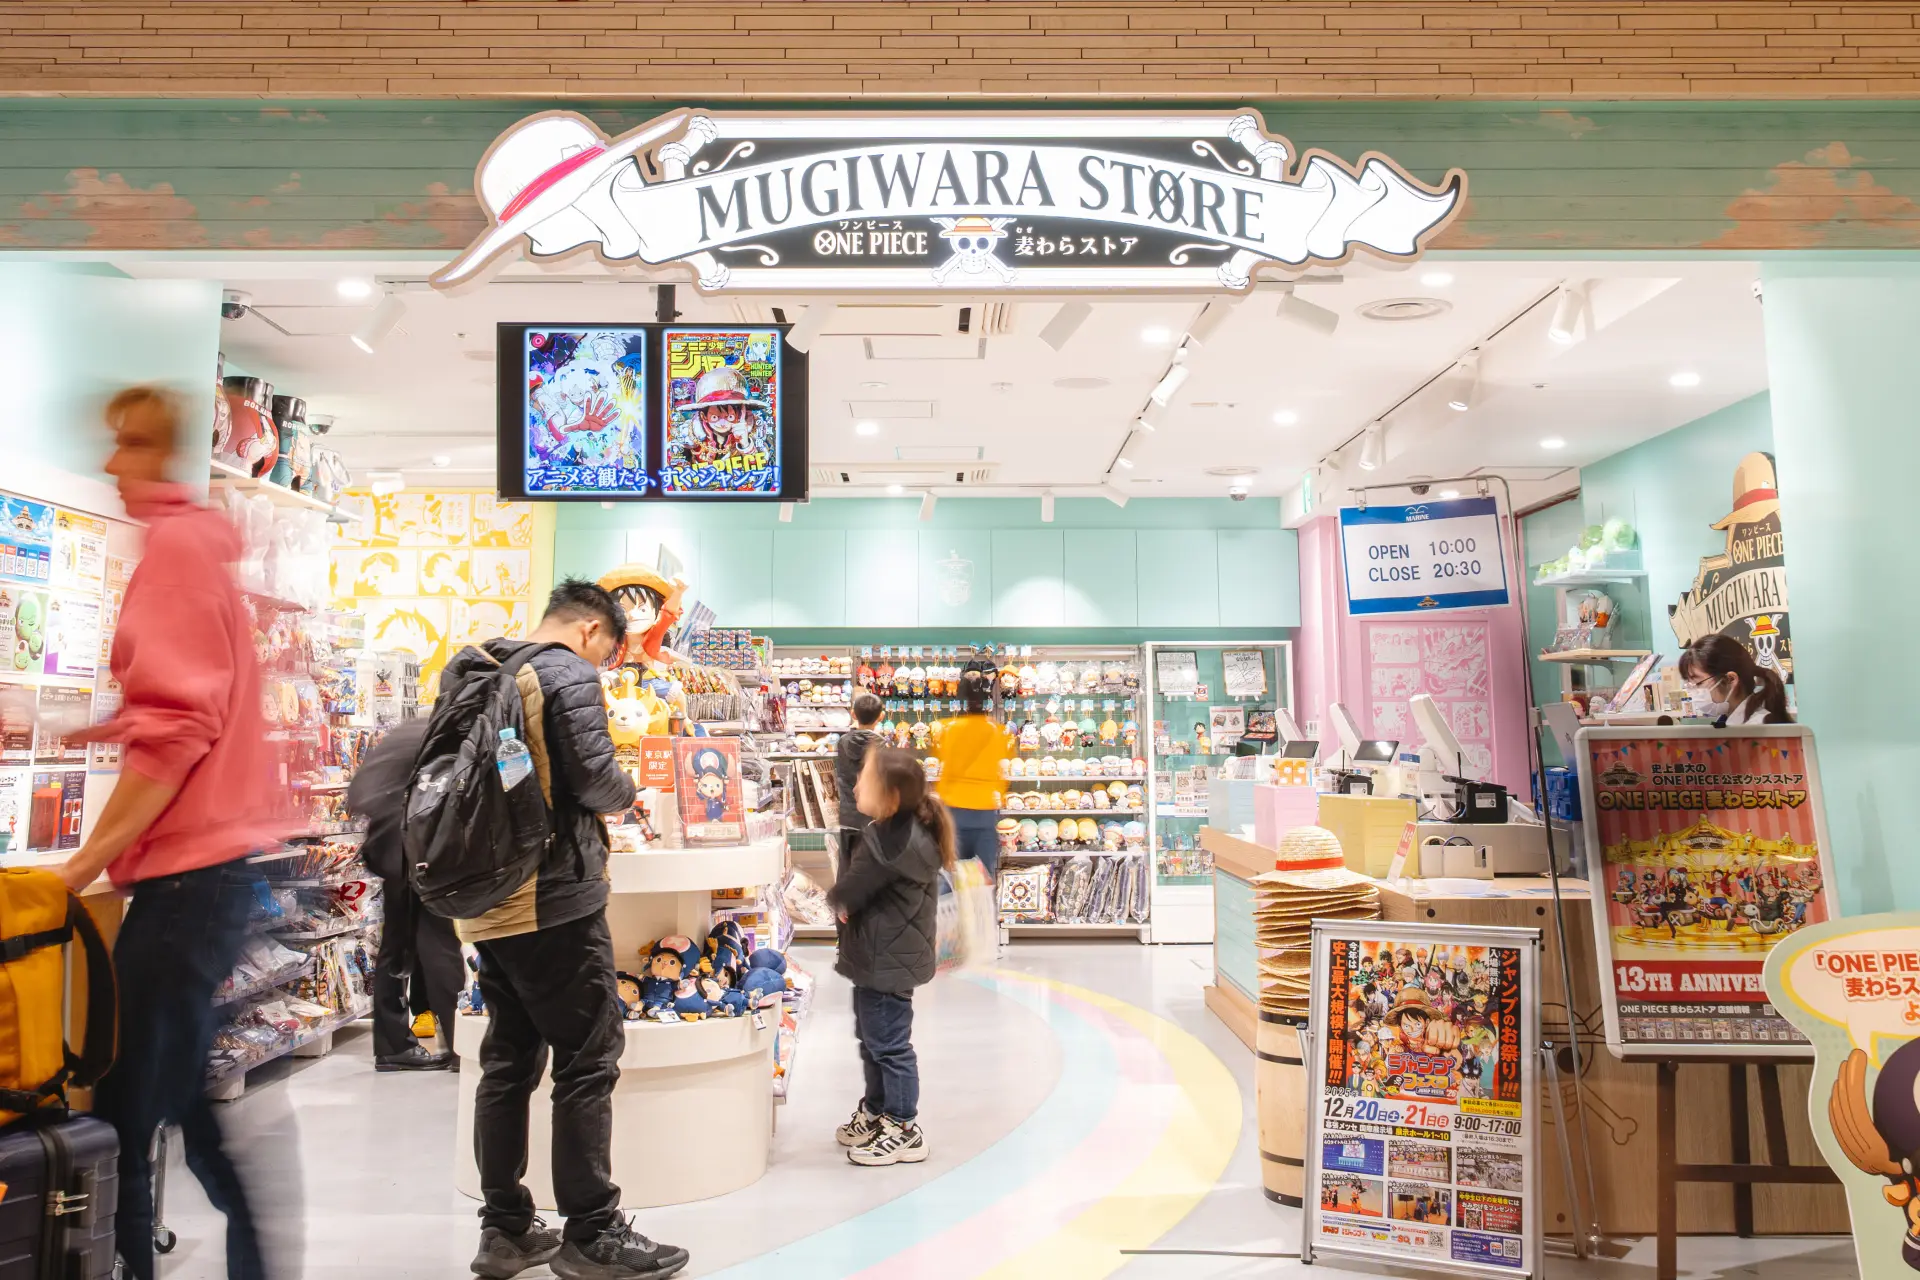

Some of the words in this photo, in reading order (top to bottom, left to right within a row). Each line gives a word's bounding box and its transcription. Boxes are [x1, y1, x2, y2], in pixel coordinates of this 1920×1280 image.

[695, 149, 1056, 243] MUGIWARA
[1078, 154, 1265, 244] STORE
[839, 220, 903, 230] ワンピース
[813, 229, 864, 255] ONE
[869, 231, 929, 255] PIECE
[1014, 236, 1140, 256] 麦わらストア
[1405, 513, 1431, 522] MARINE
[1741, 522, 1772, 537] ワンピース
[1368, 544, 1410, 560] OPEN
[1428, 537, 1477, 556] 10:00
[1732, 539, 1754, 565] ONE
[1368, 565, 1421, 582] CLOSE
[1433, 560, 1482, 578] 20:30
[1704, 569, 1782, 631] MUGIWARA
[648, 761, 668, 770] 限定
[1651, 763, 1706, 774] 史上最大の
[1652, 774, 1683, 786] ONE
[1686, 774, 1719, 786] PIECE
[1599, 790, 1645, 810] ONE
[1647, 790, 1704, 811] PIECE
[1705, 789, 1808, 810] 麦わらストア
[1347, 941, 1358, 969] 今年は
[1882, 953, 1920, 972] PIE
[1616, 965, 1674, 993] 13TH
[1620, 1005, 1640, 1014] ONE
[1642, 1005, 1669, 1014] PIECE
[1670, 1005, 1716, 1014] 麦わらストア
[1388, 1054, 1455, 1076] ジャンプ
[1402, 1073, 1449, 1090] フェスタ
